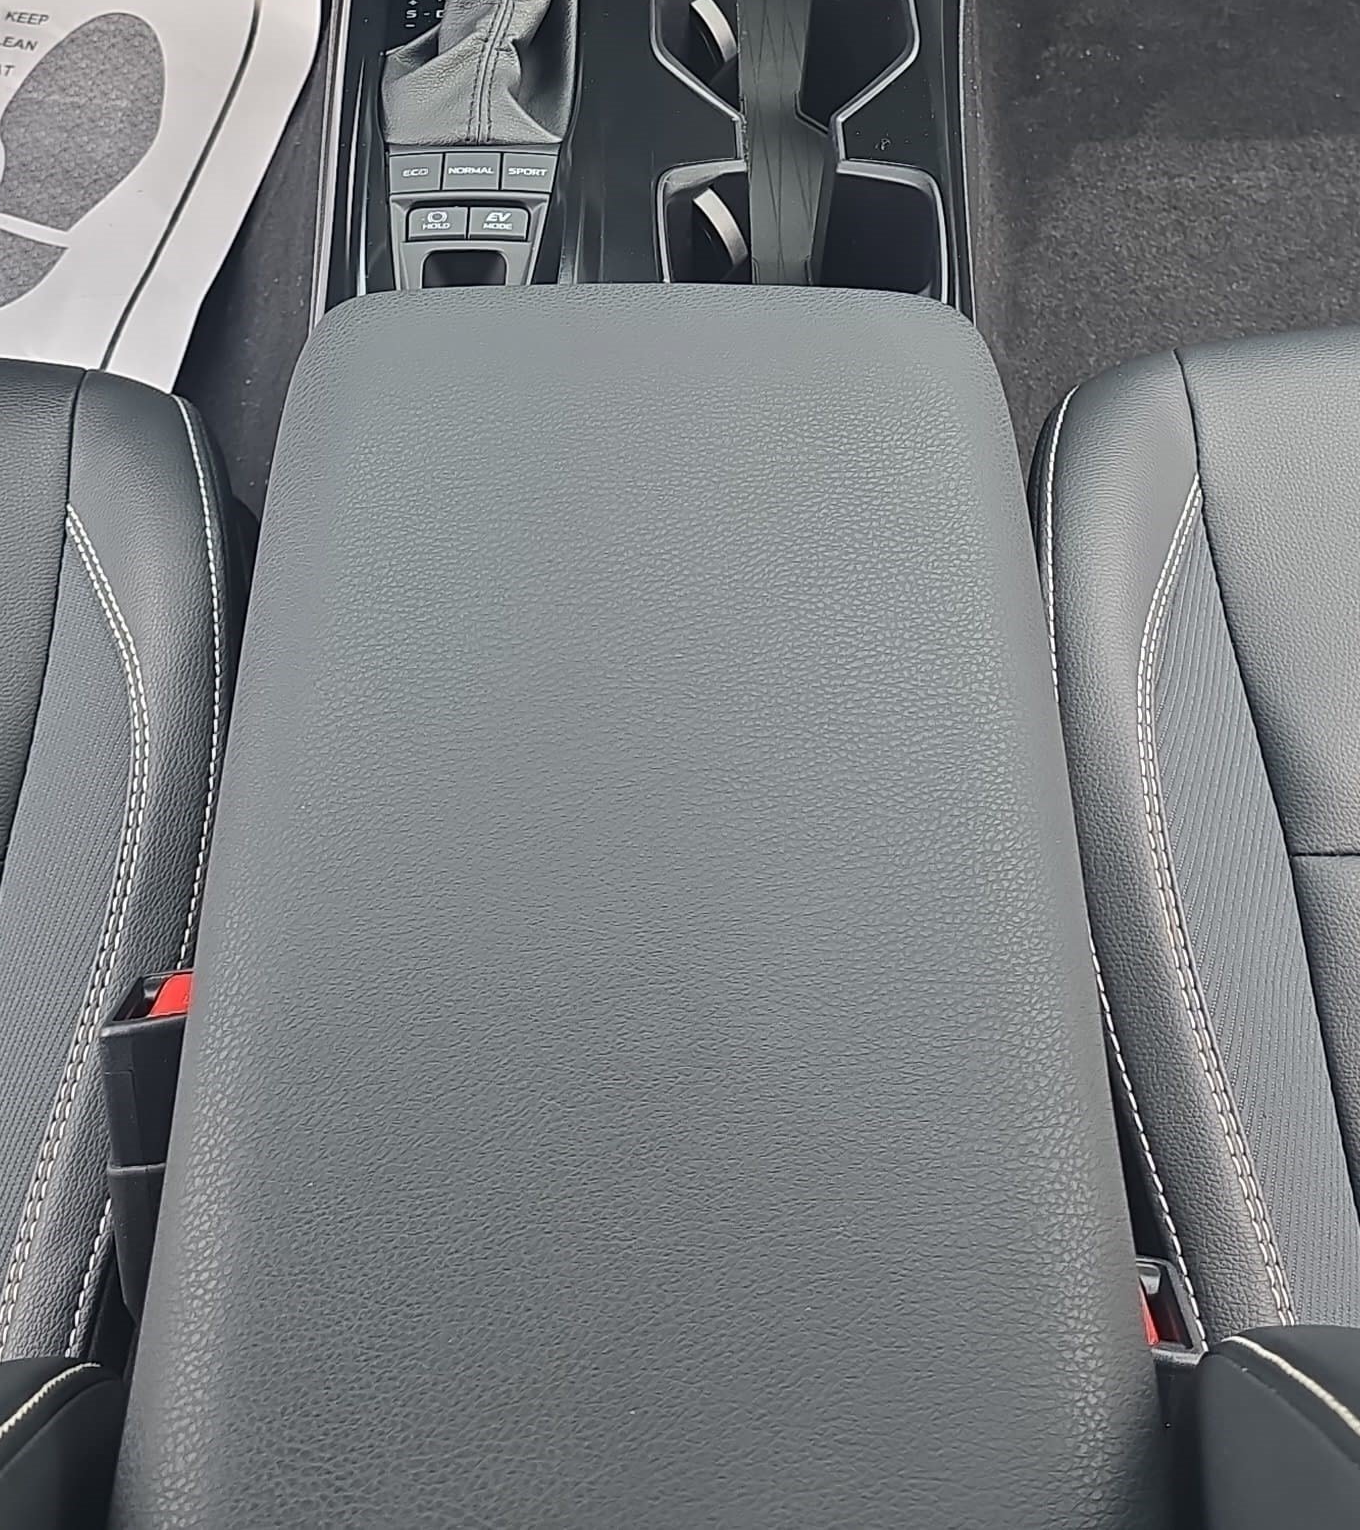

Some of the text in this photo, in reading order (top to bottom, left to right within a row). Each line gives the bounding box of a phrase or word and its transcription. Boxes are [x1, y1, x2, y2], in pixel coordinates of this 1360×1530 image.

[4, 11, 49, 26] KEEP
[406, 9, 417, 19] S
[402, 168, 429, 177] ECO
[448, 166, 495, 175] NORMAL
[508, 167, 548, 177] SPORT
[486, 212, 512, 222] EV
[422, 222, 451, 230] HOLD
